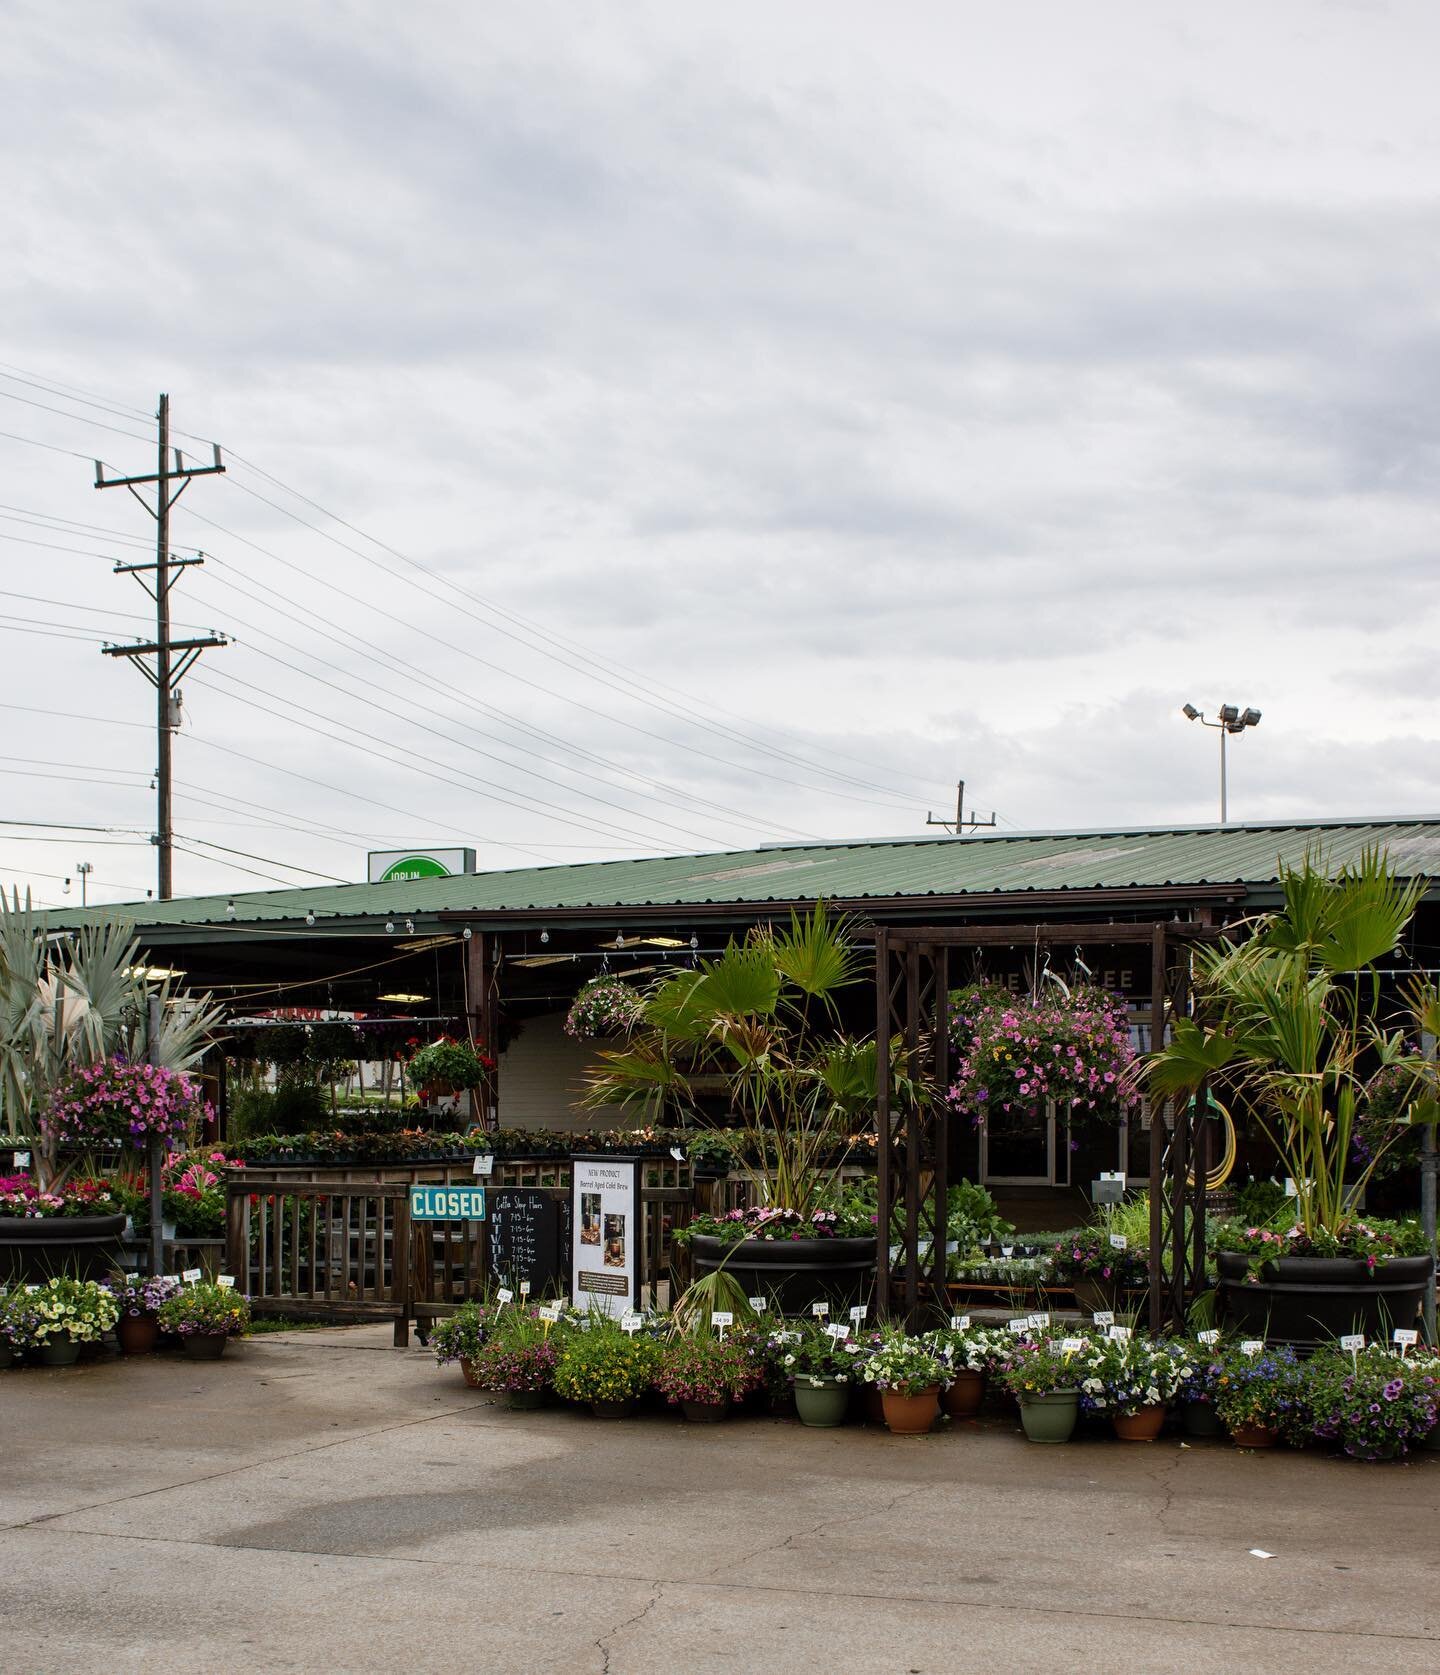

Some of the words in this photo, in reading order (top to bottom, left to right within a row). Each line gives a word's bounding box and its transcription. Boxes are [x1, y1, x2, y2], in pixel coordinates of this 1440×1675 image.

[588, 1169, 599, 1177] NEW
[600, 1169, 620, 1178] PRODUCT
[412, 1193, 483, 1216] CLOSED
[492, 1213, 502, 1223] M
